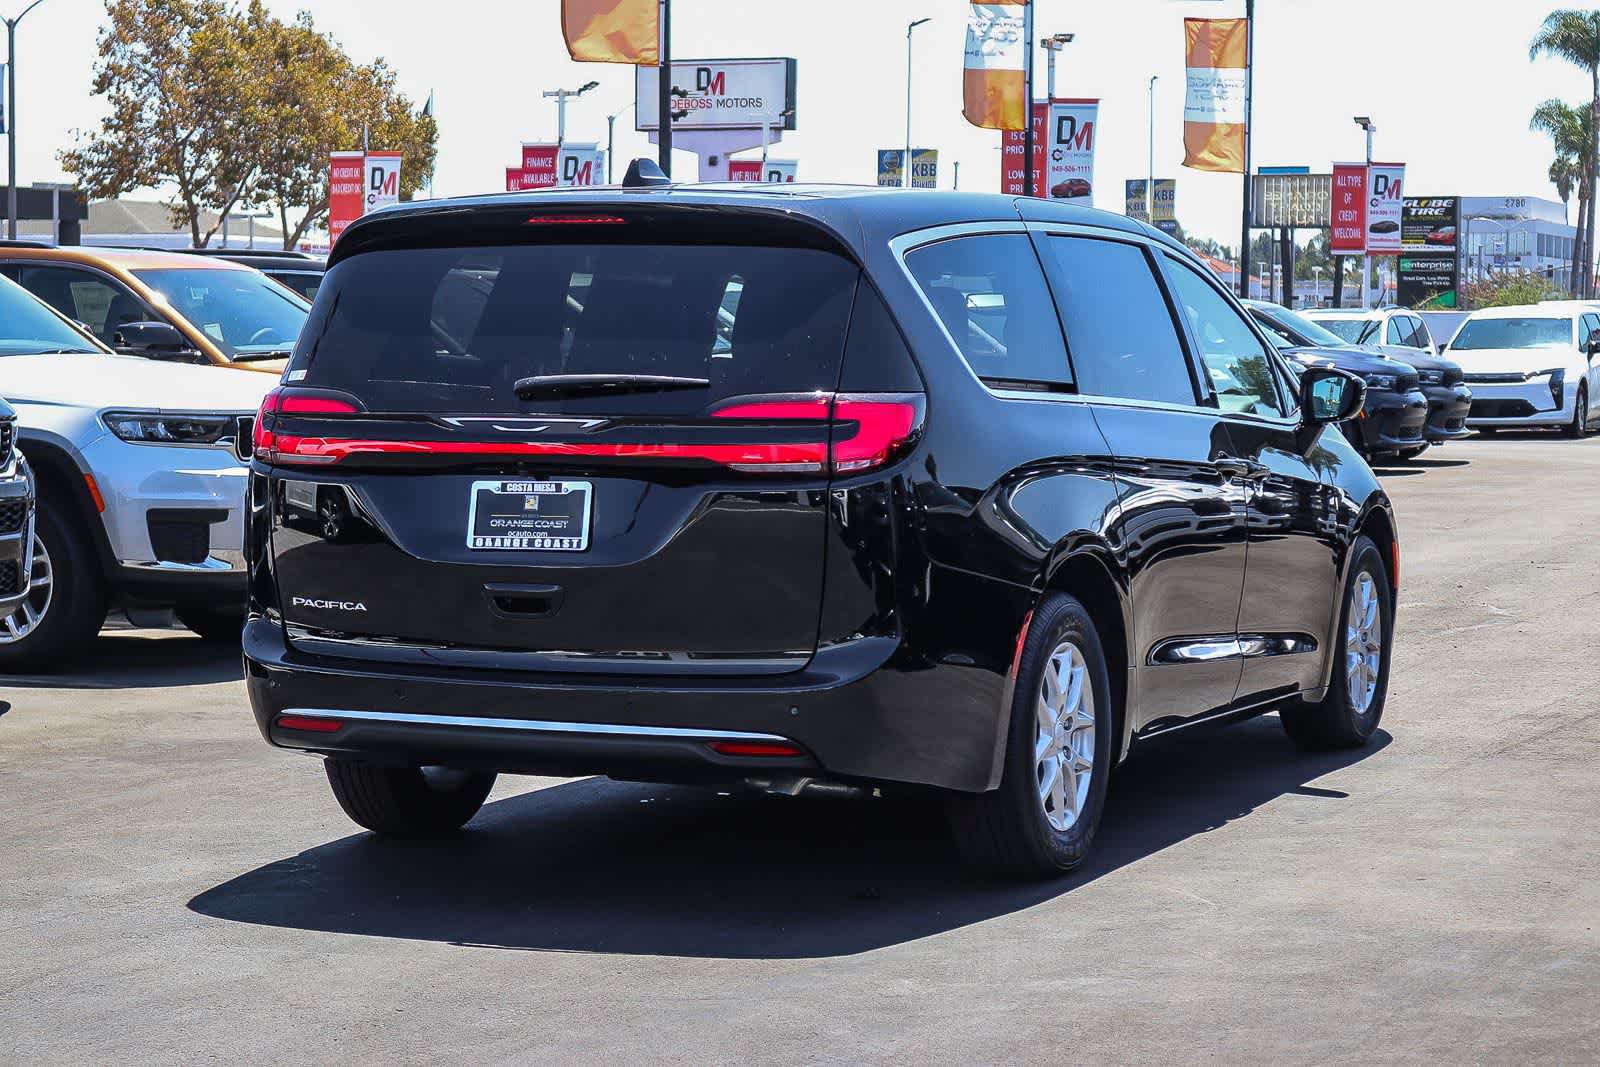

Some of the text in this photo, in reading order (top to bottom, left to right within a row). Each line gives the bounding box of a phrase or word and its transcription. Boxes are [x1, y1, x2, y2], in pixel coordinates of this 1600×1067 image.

[717, 97, 763, 109] MOTORS
[1006, 145, 1043, 155] PRIOTY
[527, 157, 553, 167] FINANCE
[912, 163, 937, 177] KBB
[1008, 169, 1040, 180] LOWST
[524, 173, 555, 184] AVAILABLE
[1337, 176, 1347, 187] ALL
[1347, 176, 1361, 187] TYPE
[1010, 183, 1039, 193] PRIS
[1154, 190, 1175, 200] KBB
[1344, 193, 1353, 205] OF
[1505, 199, 1526, 208] 2780
[1338, 210, 1358, 222] CREDIT
[1410, 207, 1446, 216] TIRE
[1334, 228, 1361, 240] WELCOME
[506, 483, 556, 492] COSTA MESA
[490, 519, 569, 529] ORANGE COAST
[507, 530, 548, 538] ocauto.com
[475, 537, 579, 548] ORANGE COAST
[292, 597, 367, 611] PACIFICA
